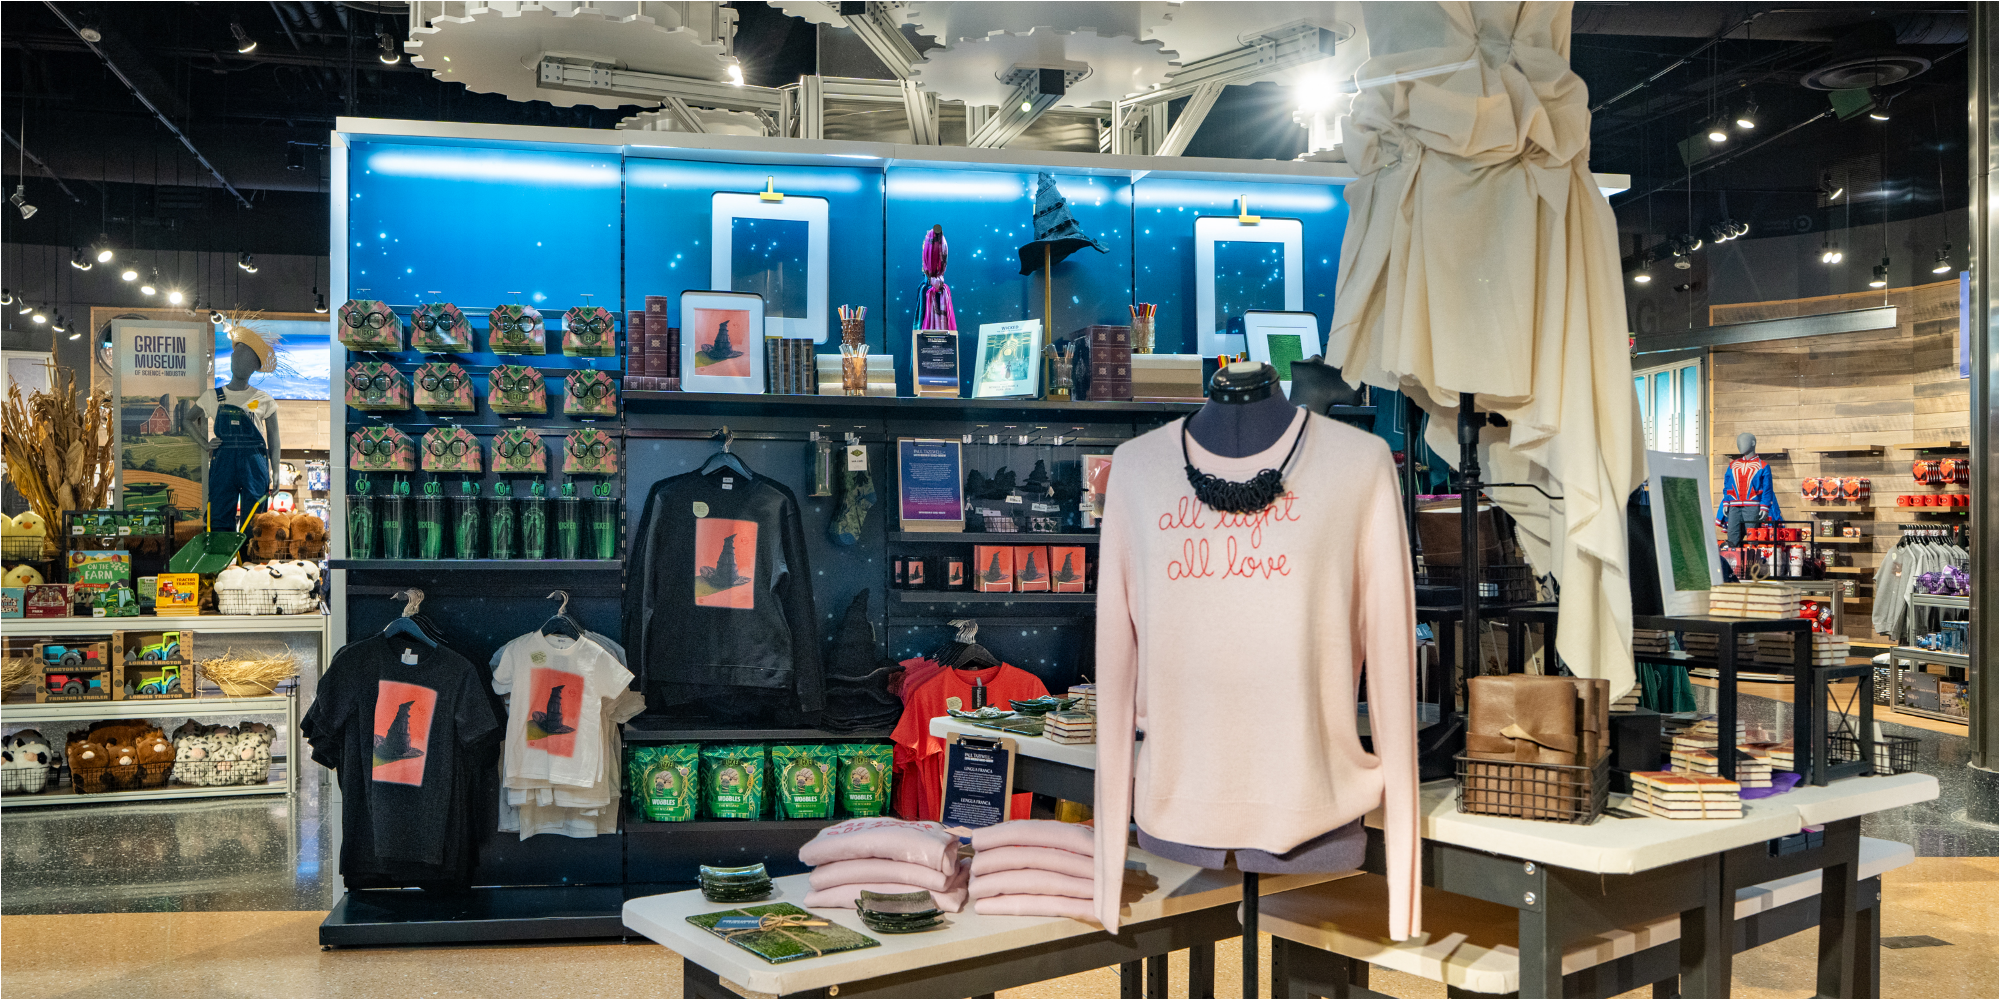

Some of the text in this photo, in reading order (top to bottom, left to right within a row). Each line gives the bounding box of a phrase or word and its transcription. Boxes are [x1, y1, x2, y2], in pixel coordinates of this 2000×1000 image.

[134, 335, 186, 354] GRIFFIN
[134, 354, 186, 369] MUSEUM
[1159, 495, 1205, 530] all
[1167, 535, 1291, 580] all love
[85, 570, 113, 579] FARM
